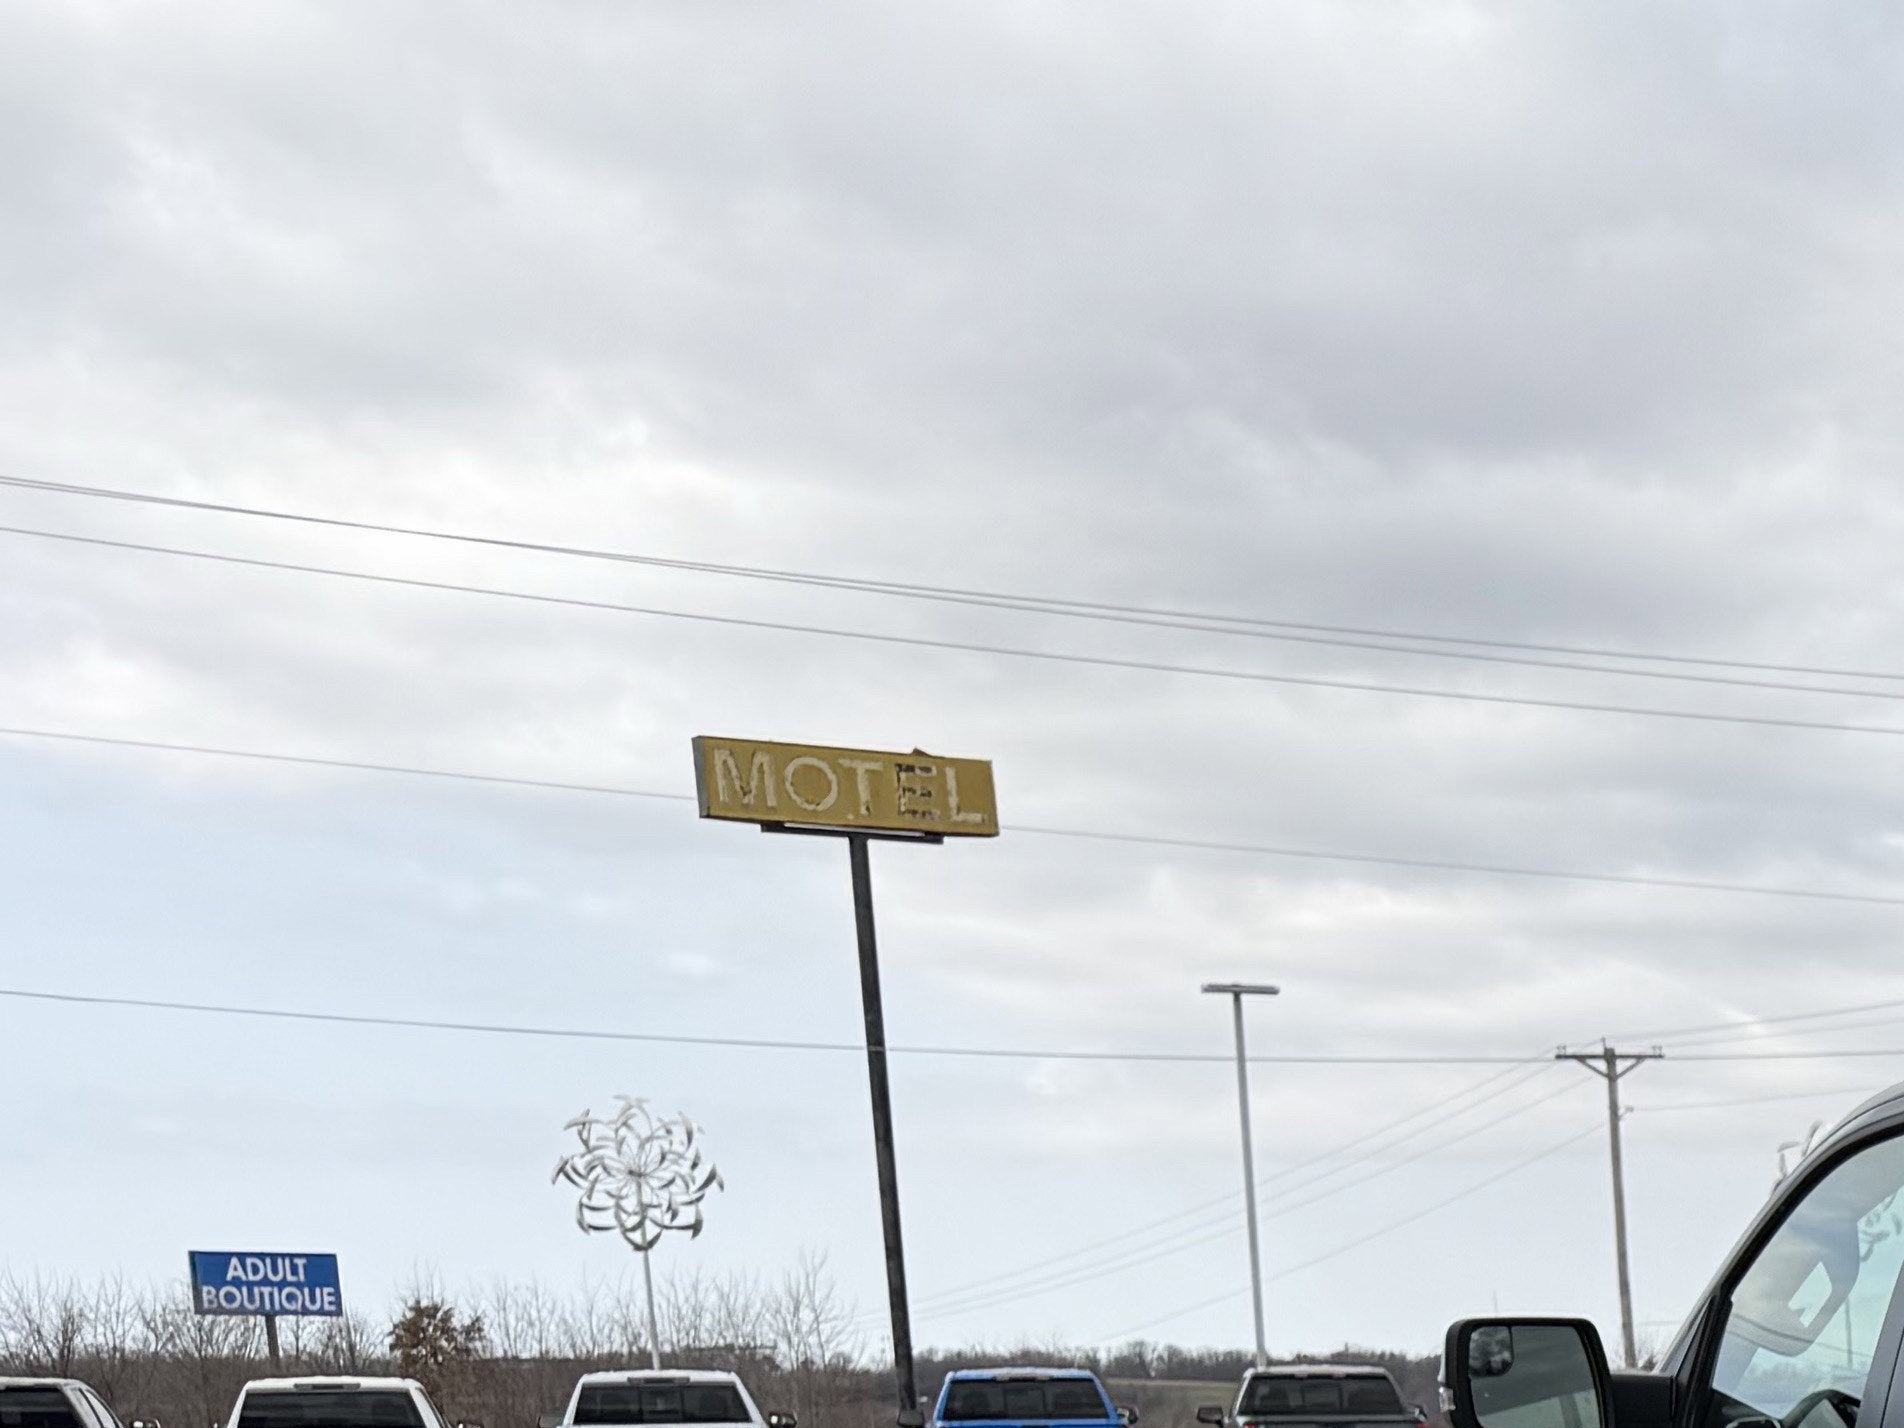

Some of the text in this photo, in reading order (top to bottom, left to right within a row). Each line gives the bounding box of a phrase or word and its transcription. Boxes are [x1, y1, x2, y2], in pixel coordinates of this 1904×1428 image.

[713, 747, 989, 824] MOTEL
[226, 1256, 308, 1283] ADULT
[202, 1285, 337, 1312] BOUTIQUE
